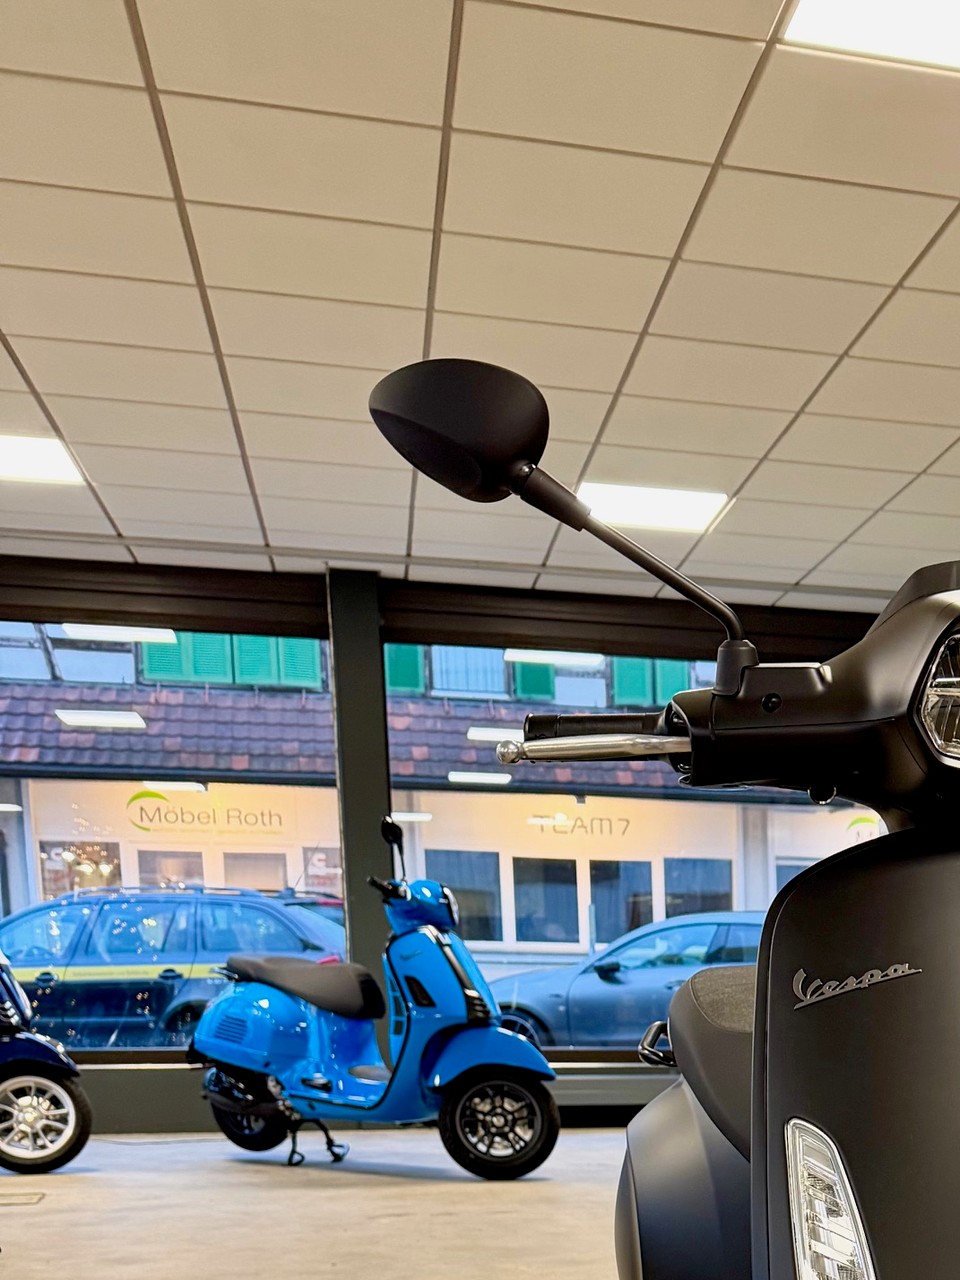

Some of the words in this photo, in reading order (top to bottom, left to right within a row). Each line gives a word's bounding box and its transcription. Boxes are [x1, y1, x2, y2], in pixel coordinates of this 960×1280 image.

[139, 806, 216, 825] Möbel
[227, 808, 283, 827] Roth
[792, 963, 922, 1010] Vespa
